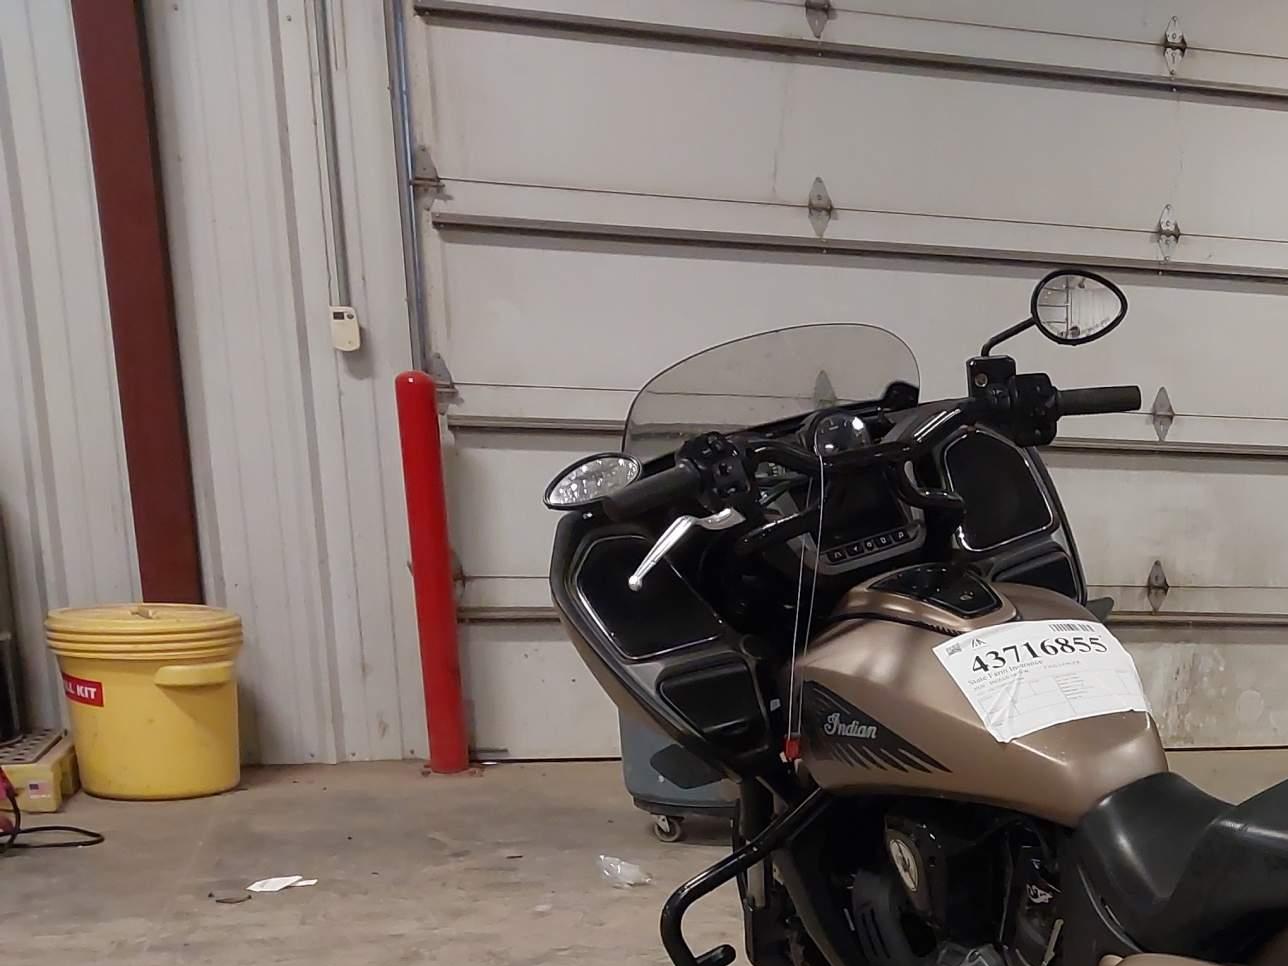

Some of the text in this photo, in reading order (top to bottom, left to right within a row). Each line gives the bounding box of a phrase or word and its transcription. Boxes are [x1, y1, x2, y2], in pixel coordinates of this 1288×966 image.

[972, 637, 1107, 672] 43716855
[76, 684, 97, 700] KIT
[824, 712, 878, 738] Indian
